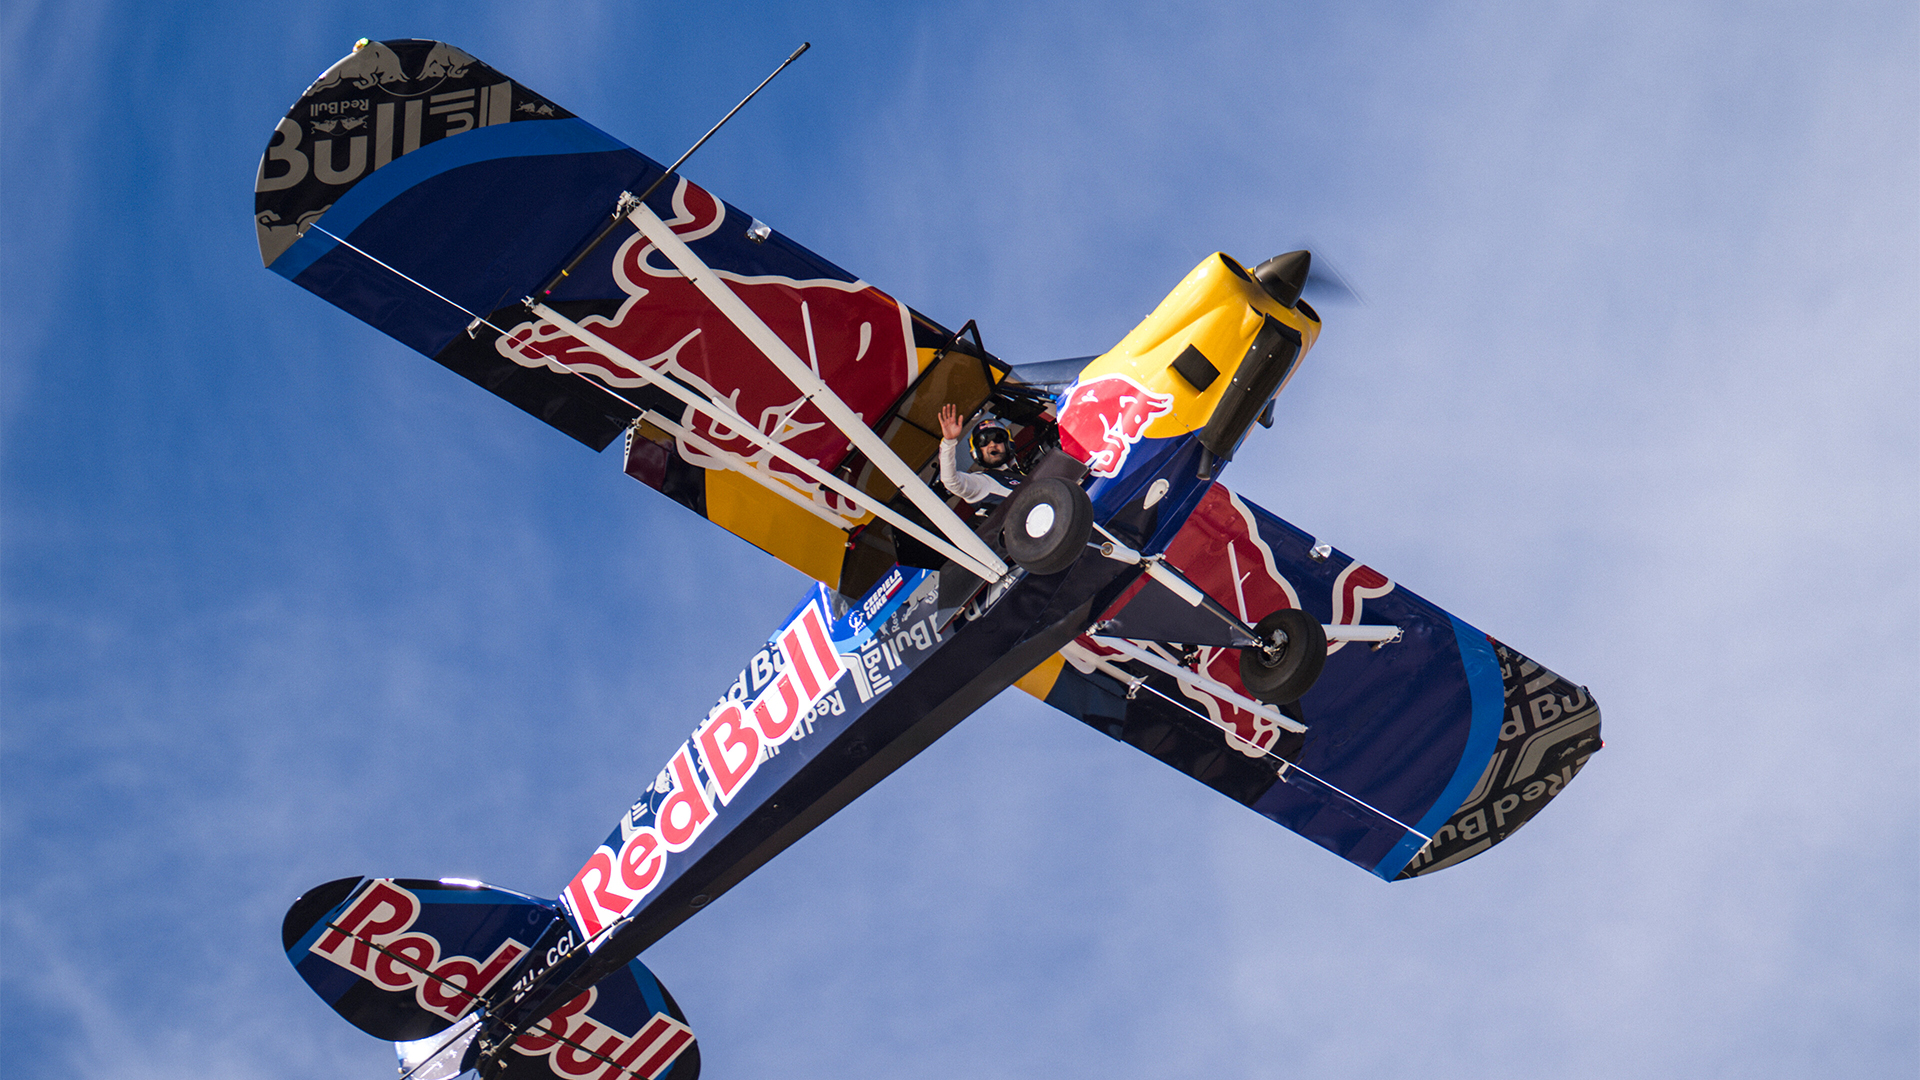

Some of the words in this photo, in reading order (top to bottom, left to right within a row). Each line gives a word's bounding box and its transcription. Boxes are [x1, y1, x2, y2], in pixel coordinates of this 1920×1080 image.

[310, 101, 338, 117] Bull
[340, 98, 369, 114] Red
[863, 568, 902, 612] CZEPIELA
[865, 593, 888, 620] LUKE
[881, 619, 933, 671] Bull
[862, 647, 893, 696] Bull
[803, 689, 846, 735] Red
[1529, 687, 1588, 729] Bu
[566, 750, 711, 943] Red
[700, 606, 841, 797] Bull
[1492, 764, 1573, 829] Red
[317, 882, 524, 1018] Red
